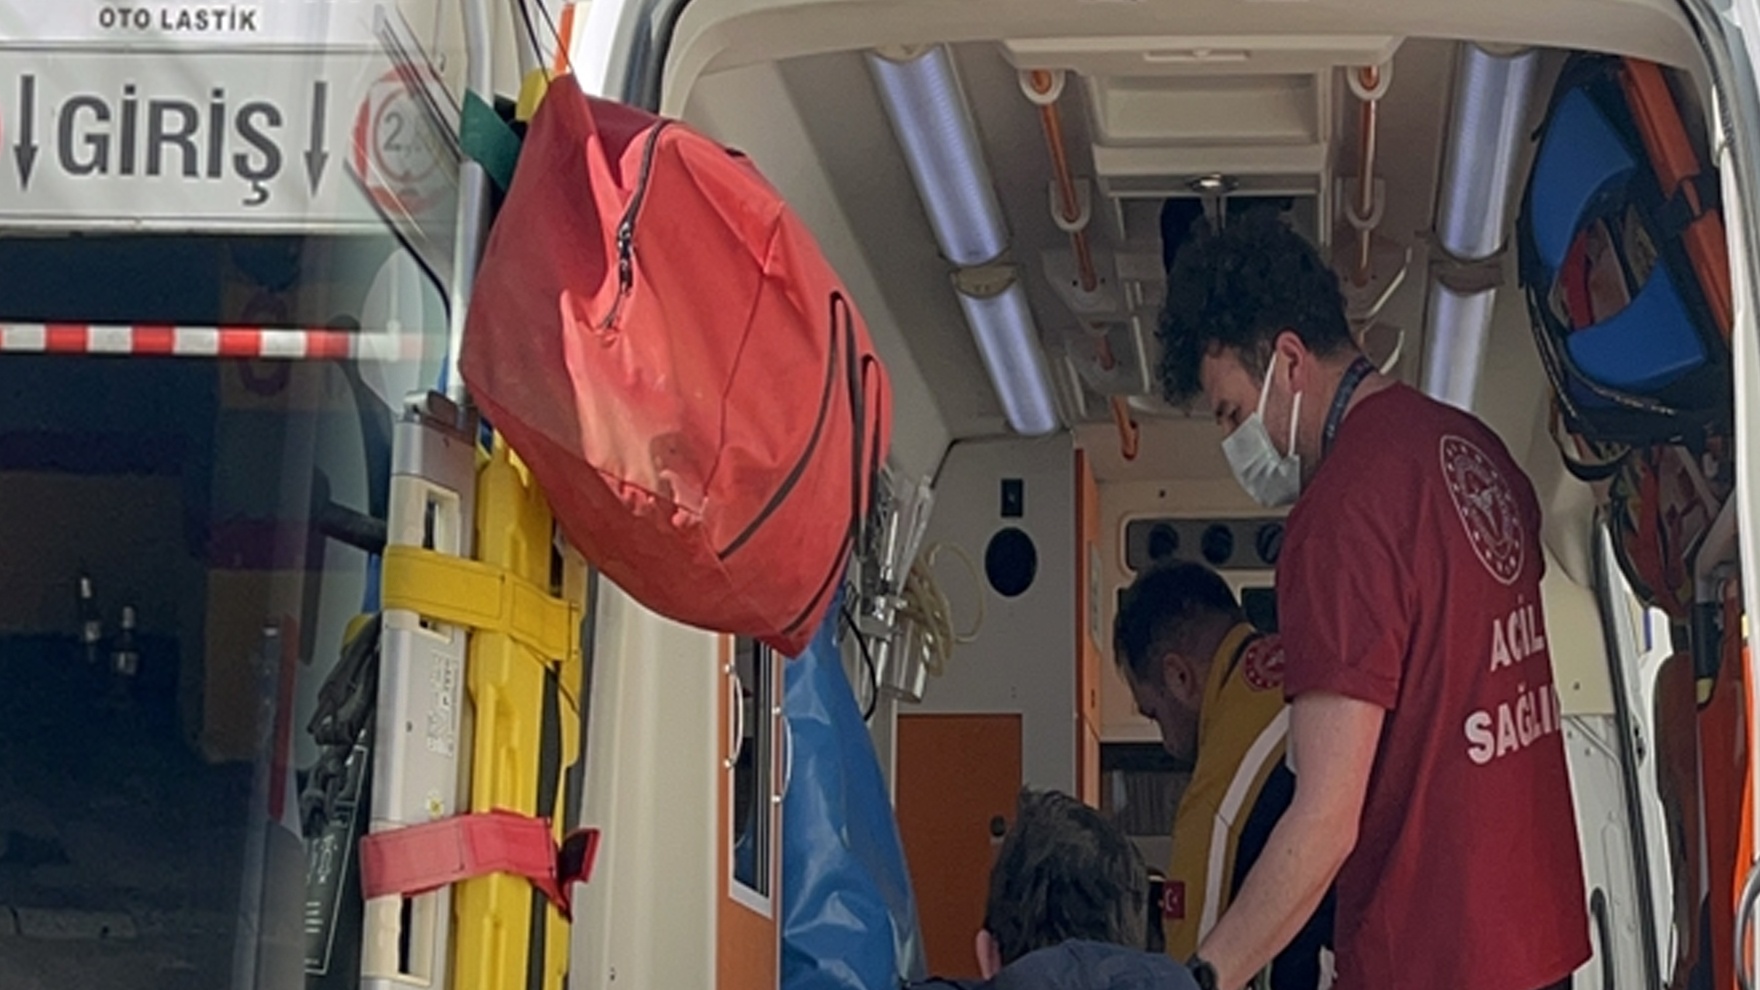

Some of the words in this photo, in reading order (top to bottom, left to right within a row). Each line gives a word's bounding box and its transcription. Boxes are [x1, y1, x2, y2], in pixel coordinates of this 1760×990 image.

[98, 7, 151, 30] OTO
[160, 4, 256, 31] LASTİK
[57, 83, 283, 206] GİRİŞ
[1490, 594, 1545, 672] ACİL
